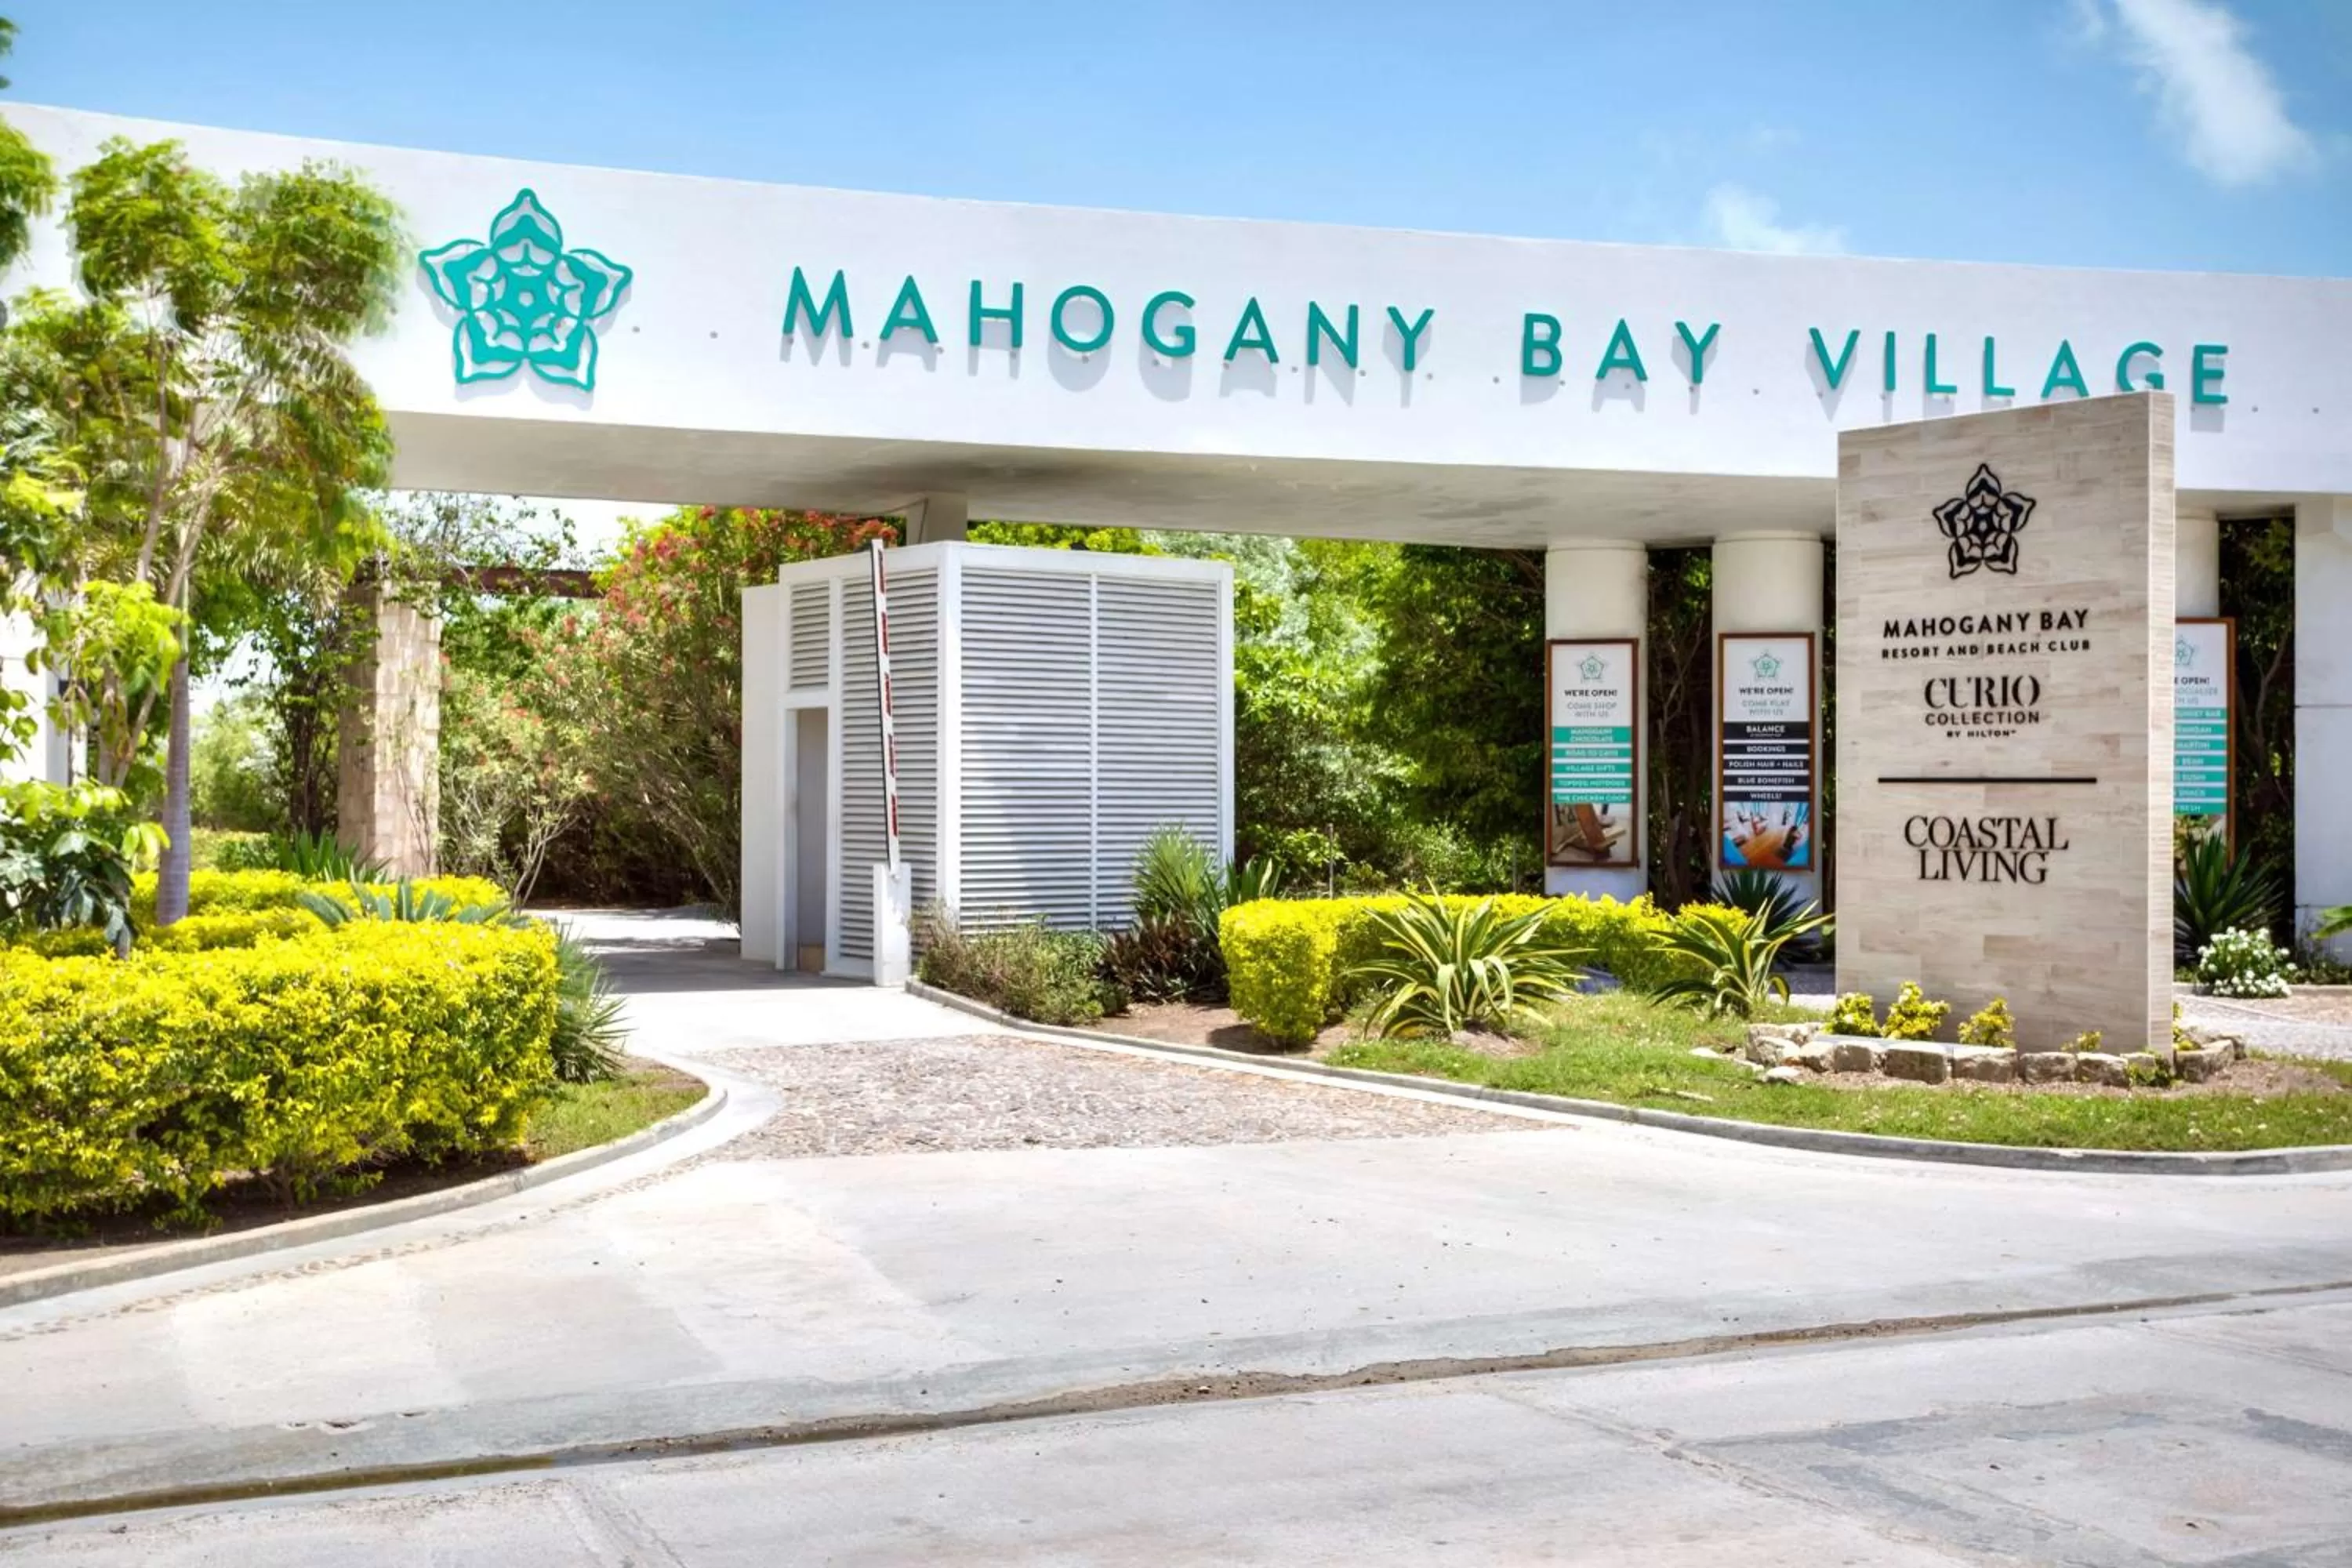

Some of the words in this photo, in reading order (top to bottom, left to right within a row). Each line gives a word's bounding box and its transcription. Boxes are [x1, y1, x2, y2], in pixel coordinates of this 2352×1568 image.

[783, 267, 1433, 371] MAHOGANY
[1522, 313, 1719, 383] BAY
[1809, 328, 2227, 405] VILLAGE
[1883, 612, 2031, 638] MAHOGANY
[2040, 608, 2089, 631] BAY
[1882, 646, 1939, 659] RESORT
[1947, 644, 1980, 656] AND
[1987, 642, 2040, 655] BEACH
[2048, 639, 2090, 652] CLUB
[1924, 675, 2041, 709] CURIO
[2181, 677, 2210, 685] OPEN!
[1746, 724, 1785, 733] BALANCE
[1925, 711, 2040, 726] COLLECTION
[1904, 815, 2070, 851] COASTAL
[1918, 849, 2049, 884] LIVING
